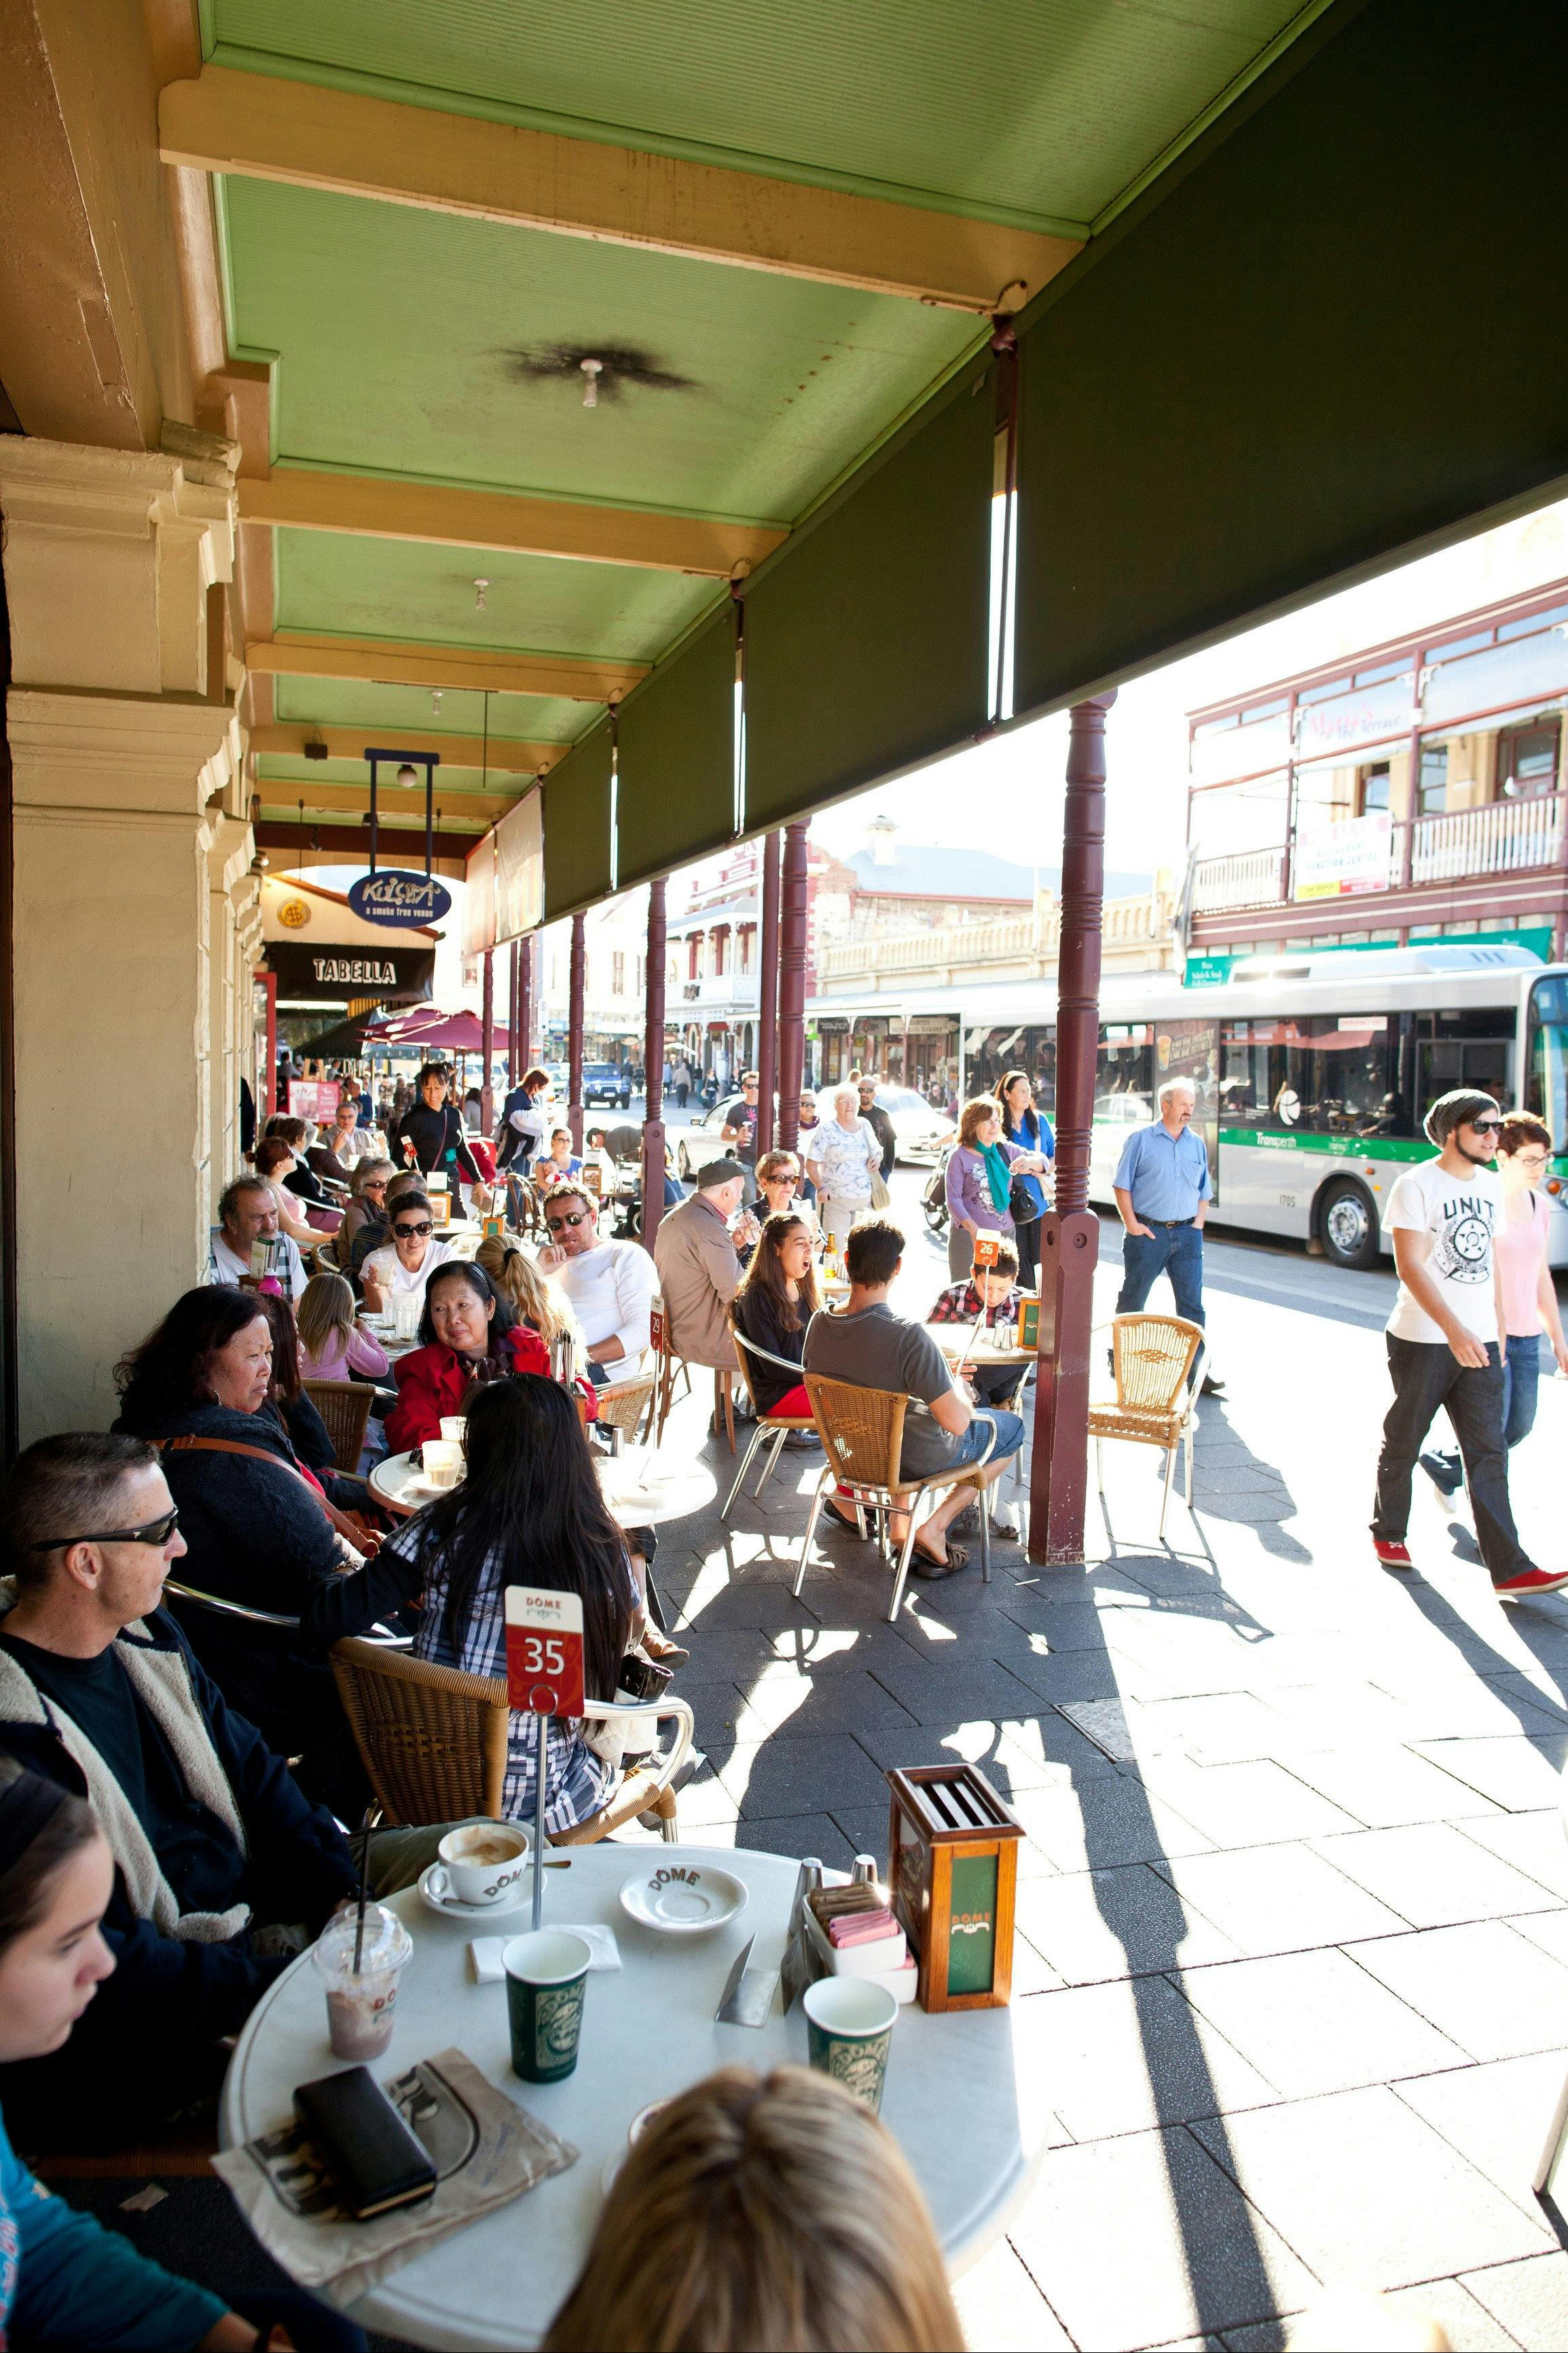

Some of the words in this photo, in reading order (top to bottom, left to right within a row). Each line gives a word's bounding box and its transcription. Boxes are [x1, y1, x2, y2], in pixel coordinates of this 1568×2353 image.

[365, 907, 371, 915] a
[372, 907, 395, 916] smoke
[397, 908, 412, 917] free
[414, 909, 433, 917] venue
[313, 958, 397, 985] TABELLA
[1256, 1131, 1297, 1149] Transperth
[1279, 1194, 1296, 1207] 1705
[1444, 1197, 1493, 1220] UNIT
[981, 1243, 993, 1255] 26
[653, 1317, 660, 1334] 29
[525, 1637, 565, 1675] 35
